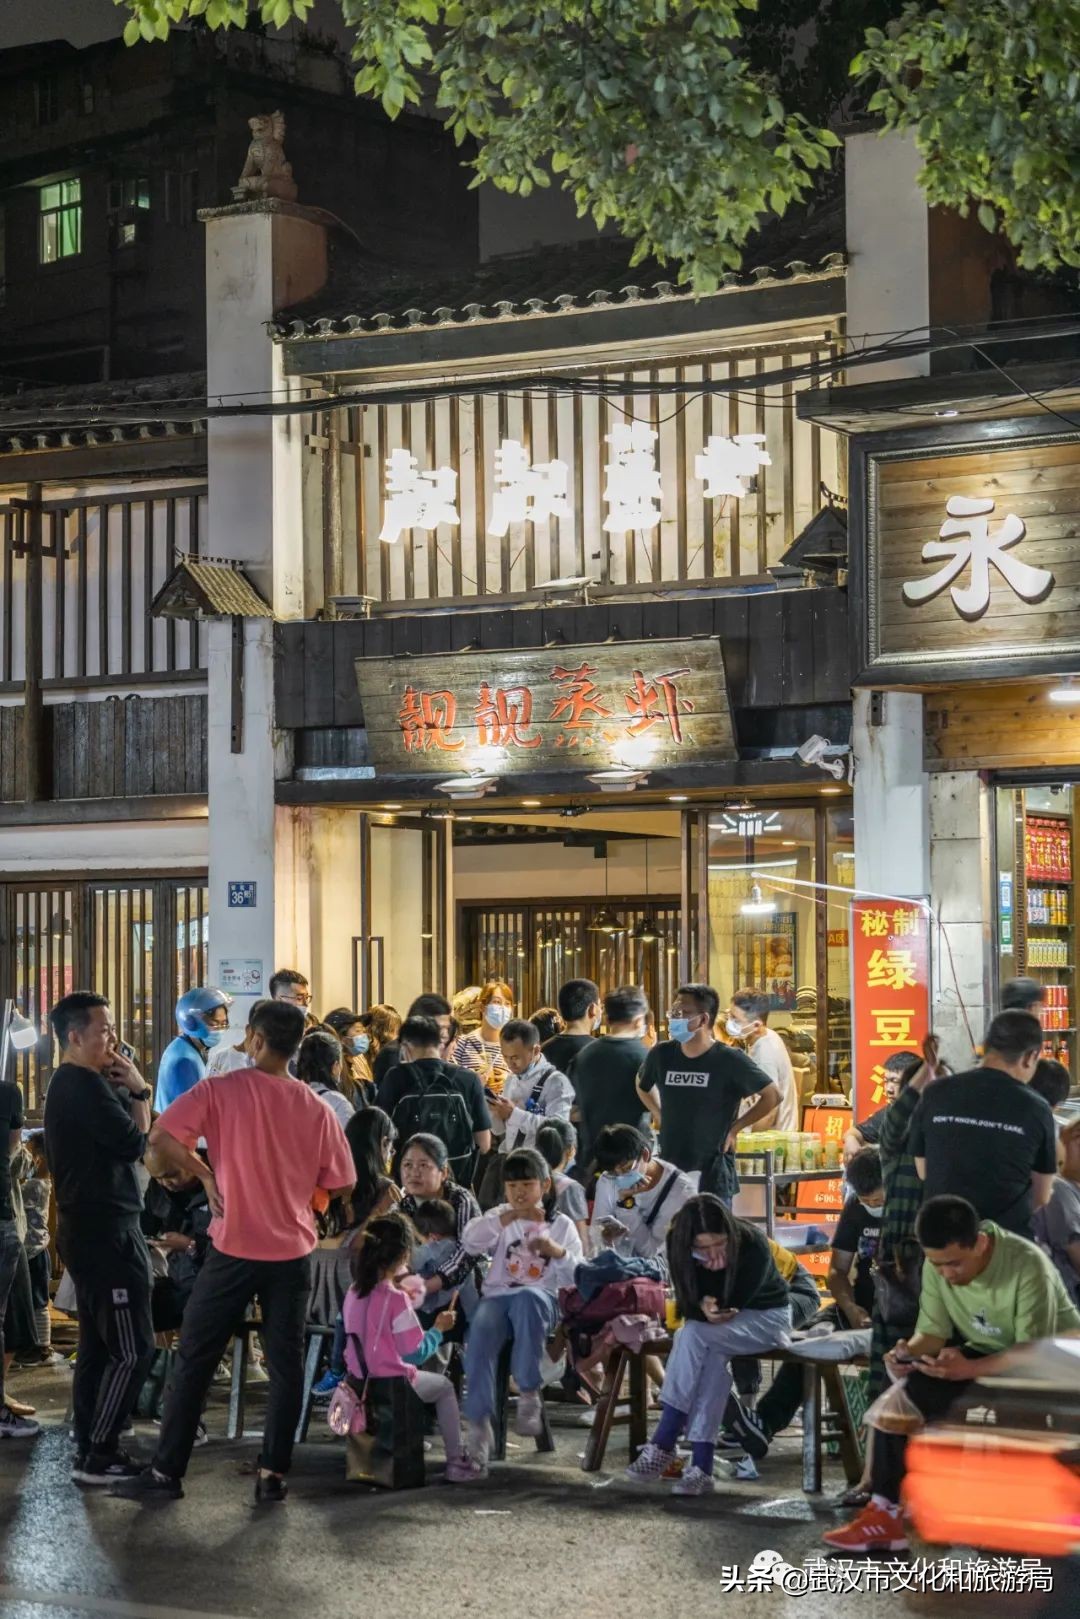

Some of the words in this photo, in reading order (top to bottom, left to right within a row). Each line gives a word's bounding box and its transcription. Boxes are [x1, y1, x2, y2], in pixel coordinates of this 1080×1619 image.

[903, 496, 1052, 614] 永
[399, 662, 695, 753] 靓靓蒸虾
[861, 908, 920, 937] 秘制
